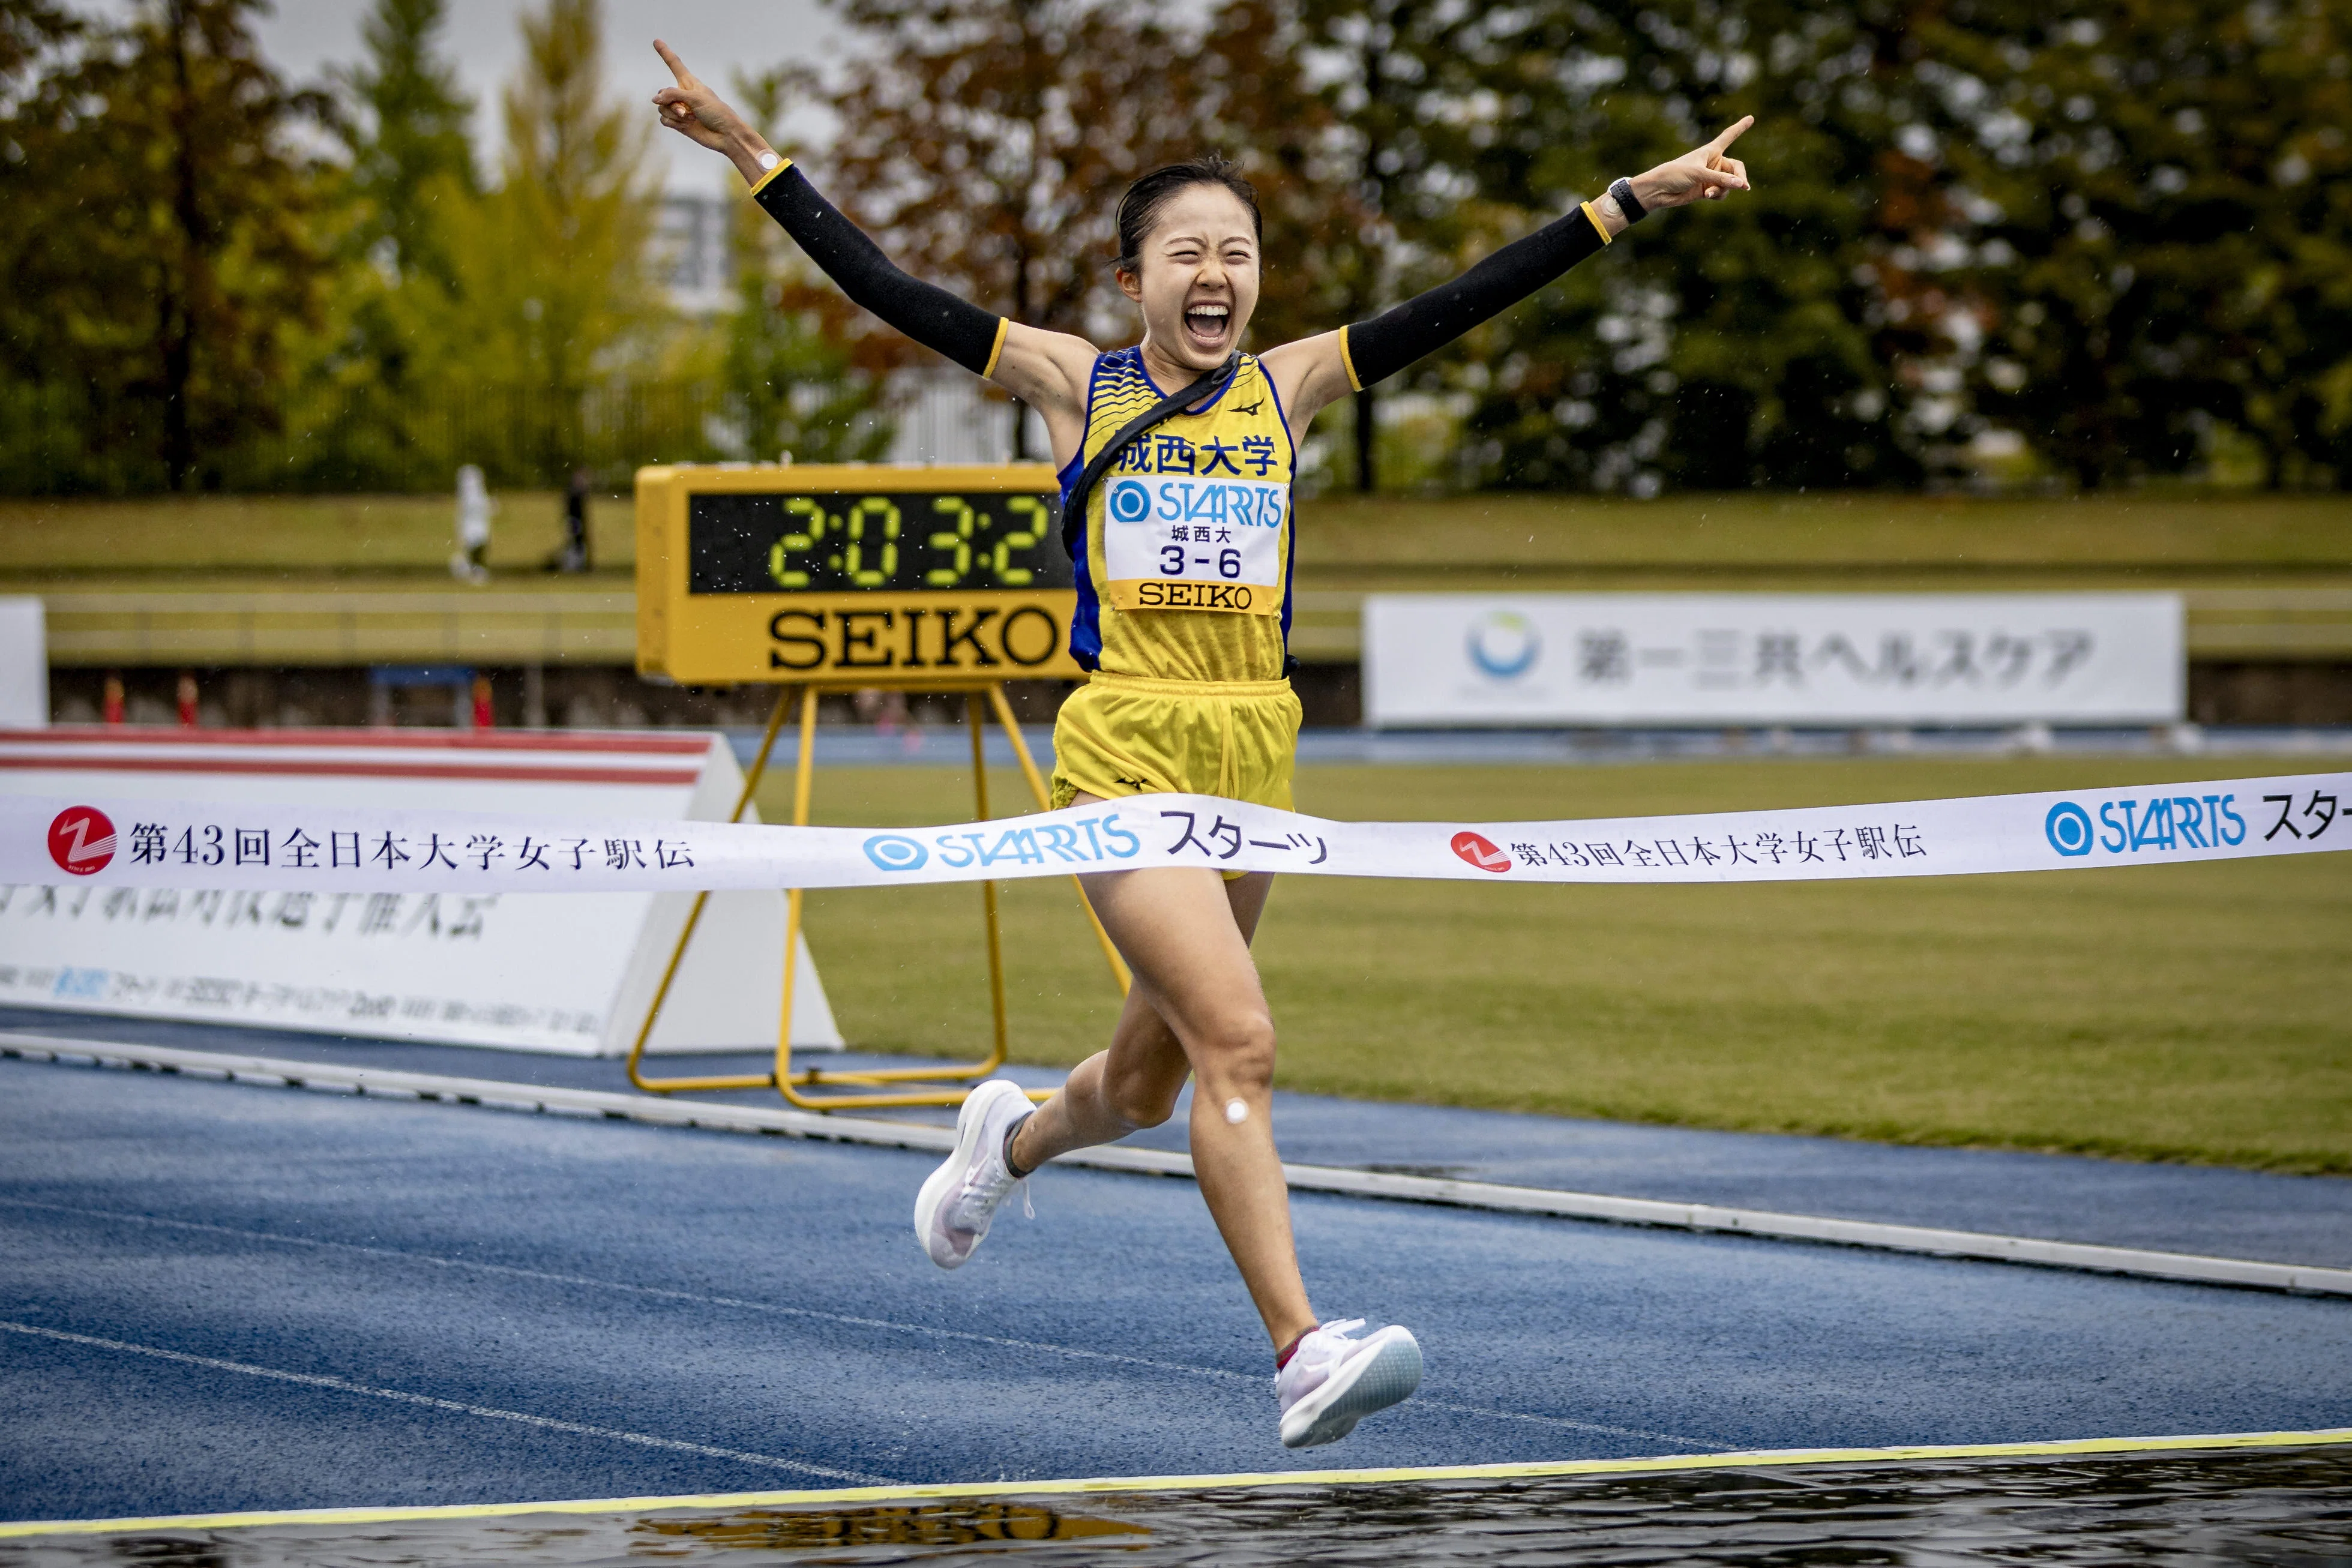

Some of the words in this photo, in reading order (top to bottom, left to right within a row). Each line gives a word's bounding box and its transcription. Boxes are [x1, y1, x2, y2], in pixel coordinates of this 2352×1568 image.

[1171, 524, 1232, 544] 城西大
[1139, 581, 1253, 610] SEIKO
[769, 606, 1060, 670] SEIKO
[129, 822, 695, 871] 第43回全日本大学女子駅伝
[1160, 810, 1328, 865] スターツ
[1510, 823, 1928, 868] 第43回全日本大学女子駅伝
